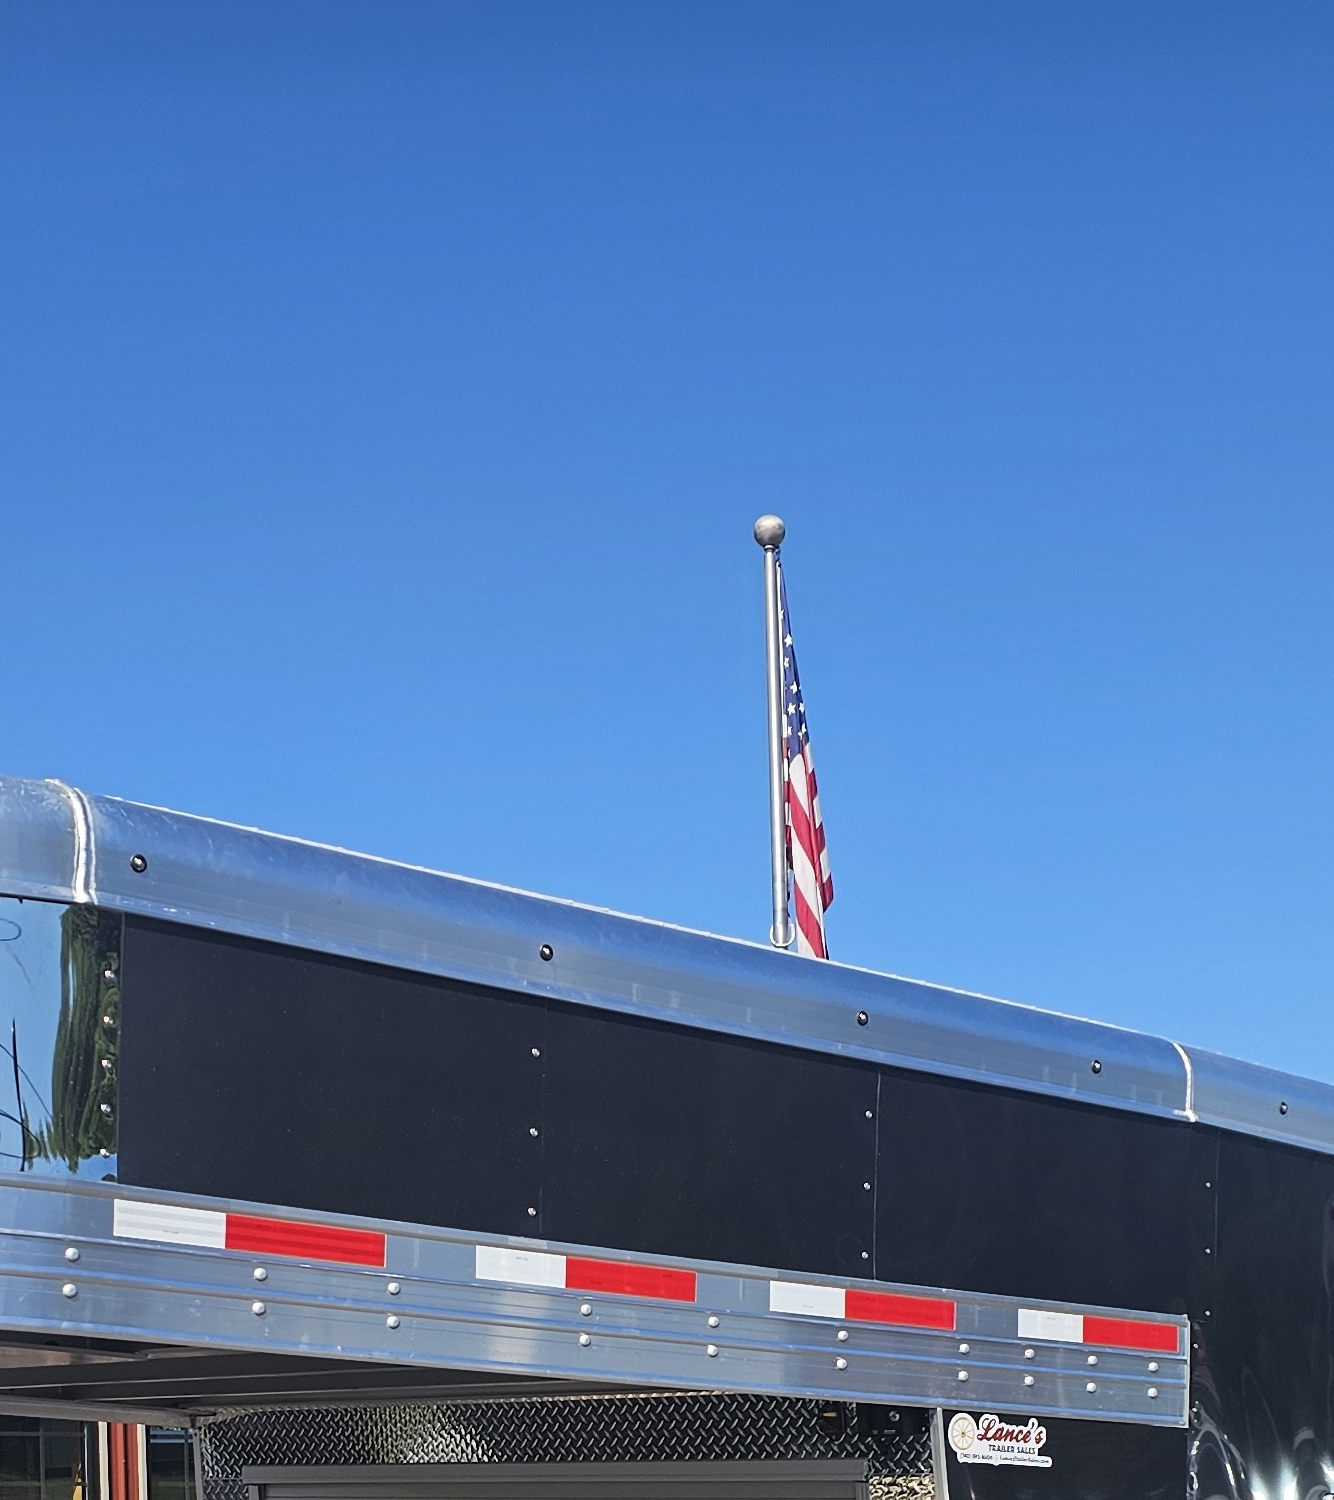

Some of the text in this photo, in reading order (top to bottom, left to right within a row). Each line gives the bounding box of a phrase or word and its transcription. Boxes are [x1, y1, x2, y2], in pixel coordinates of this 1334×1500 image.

[976, 1417, 1044, 1445] Lance's
[988, 1443, 1036, 1455] TRAILER SALES
